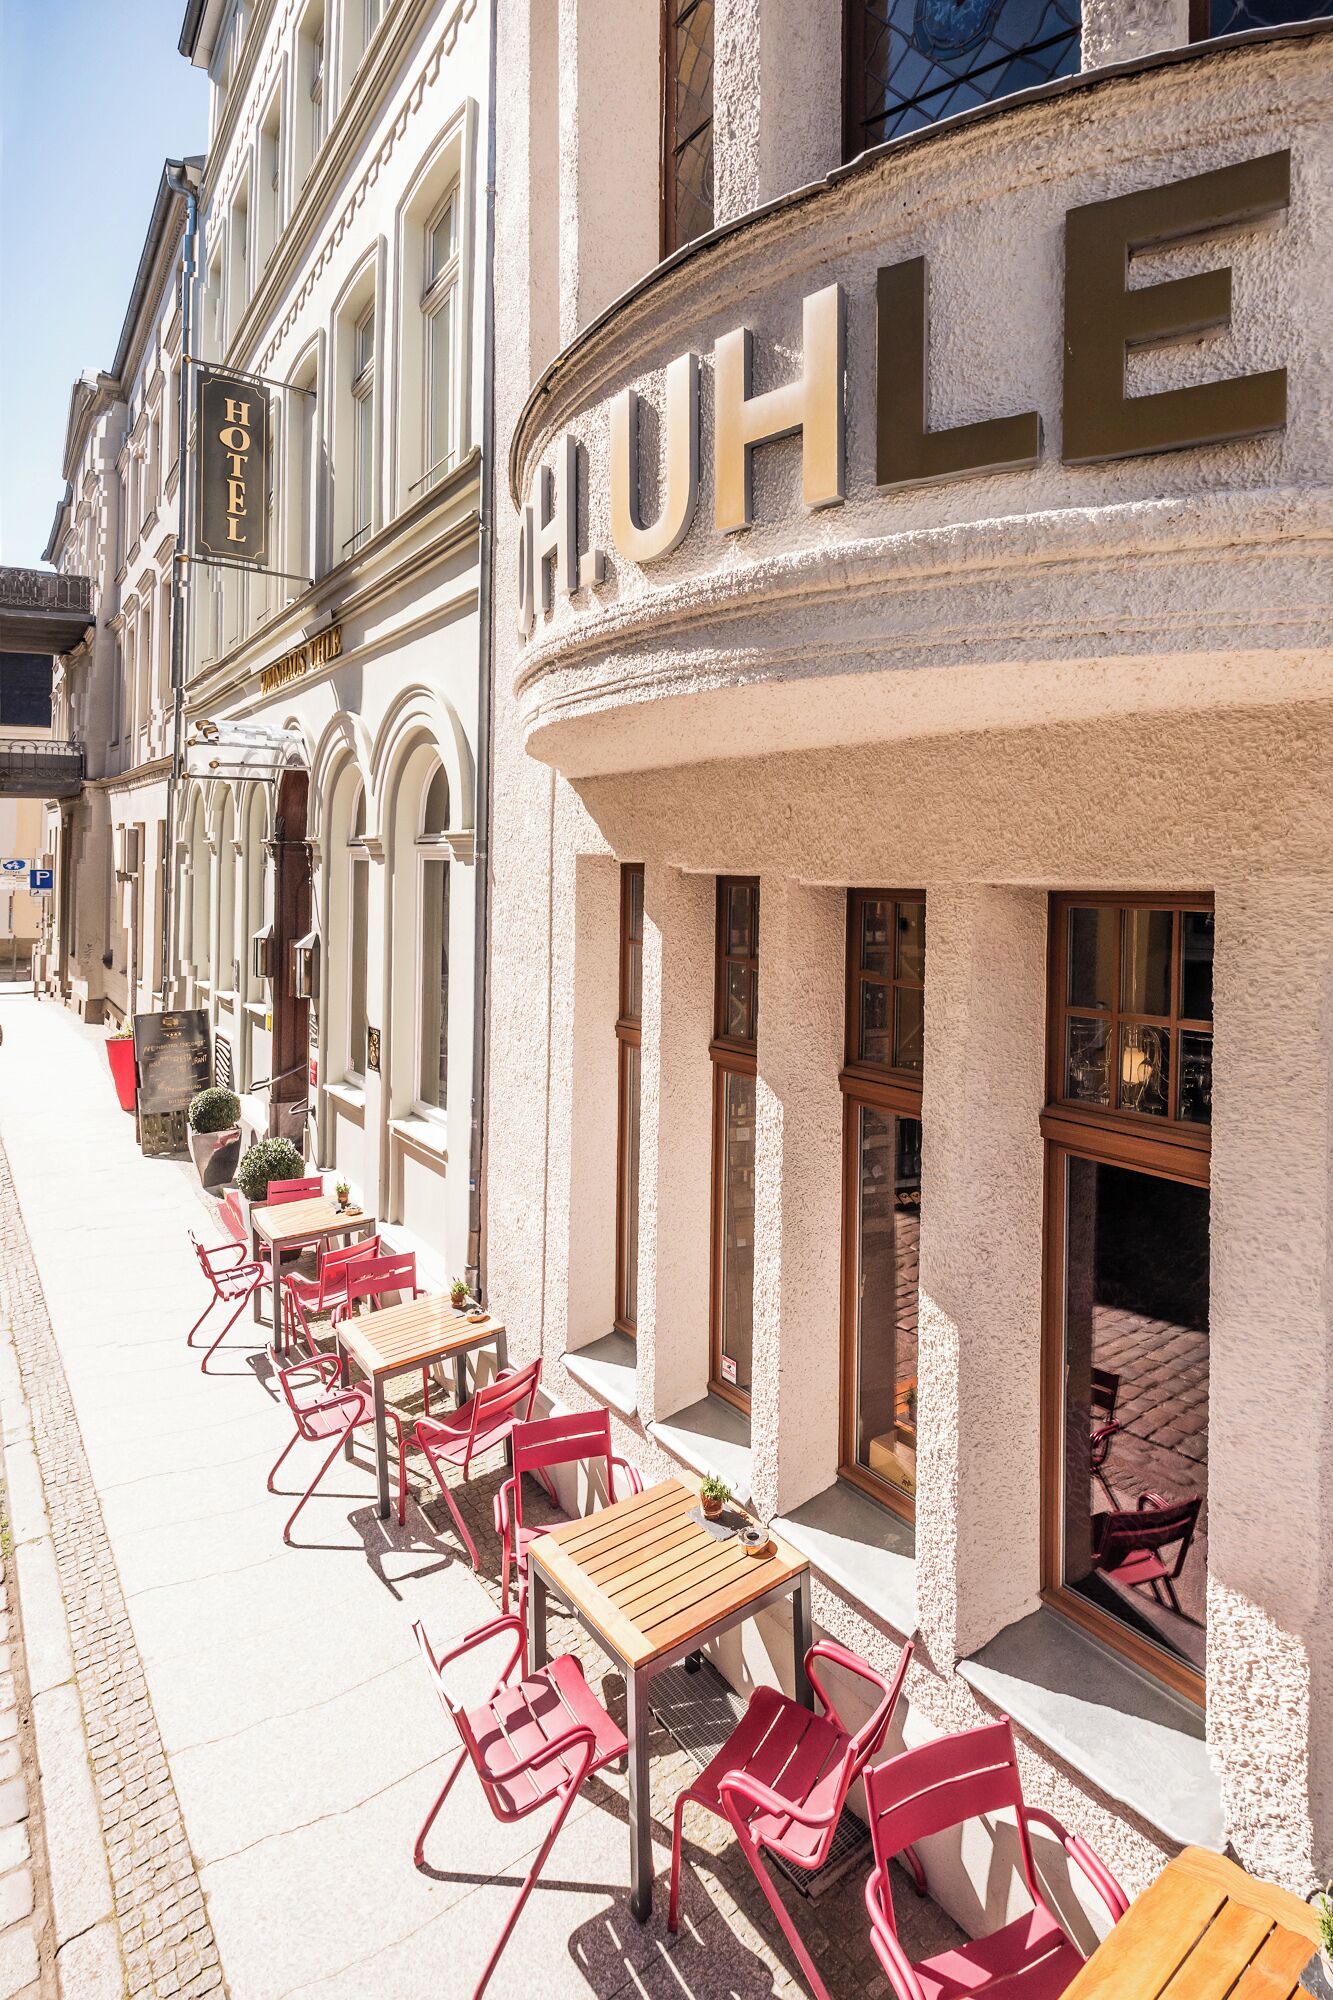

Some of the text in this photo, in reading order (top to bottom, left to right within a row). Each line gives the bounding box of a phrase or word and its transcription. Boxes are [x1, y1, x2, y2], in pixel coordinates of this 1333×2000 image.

[610, 149, 1290, 563] UHLE
[219, 398, 251, 543] HOTEL
[36, 871, 50, 886] P
